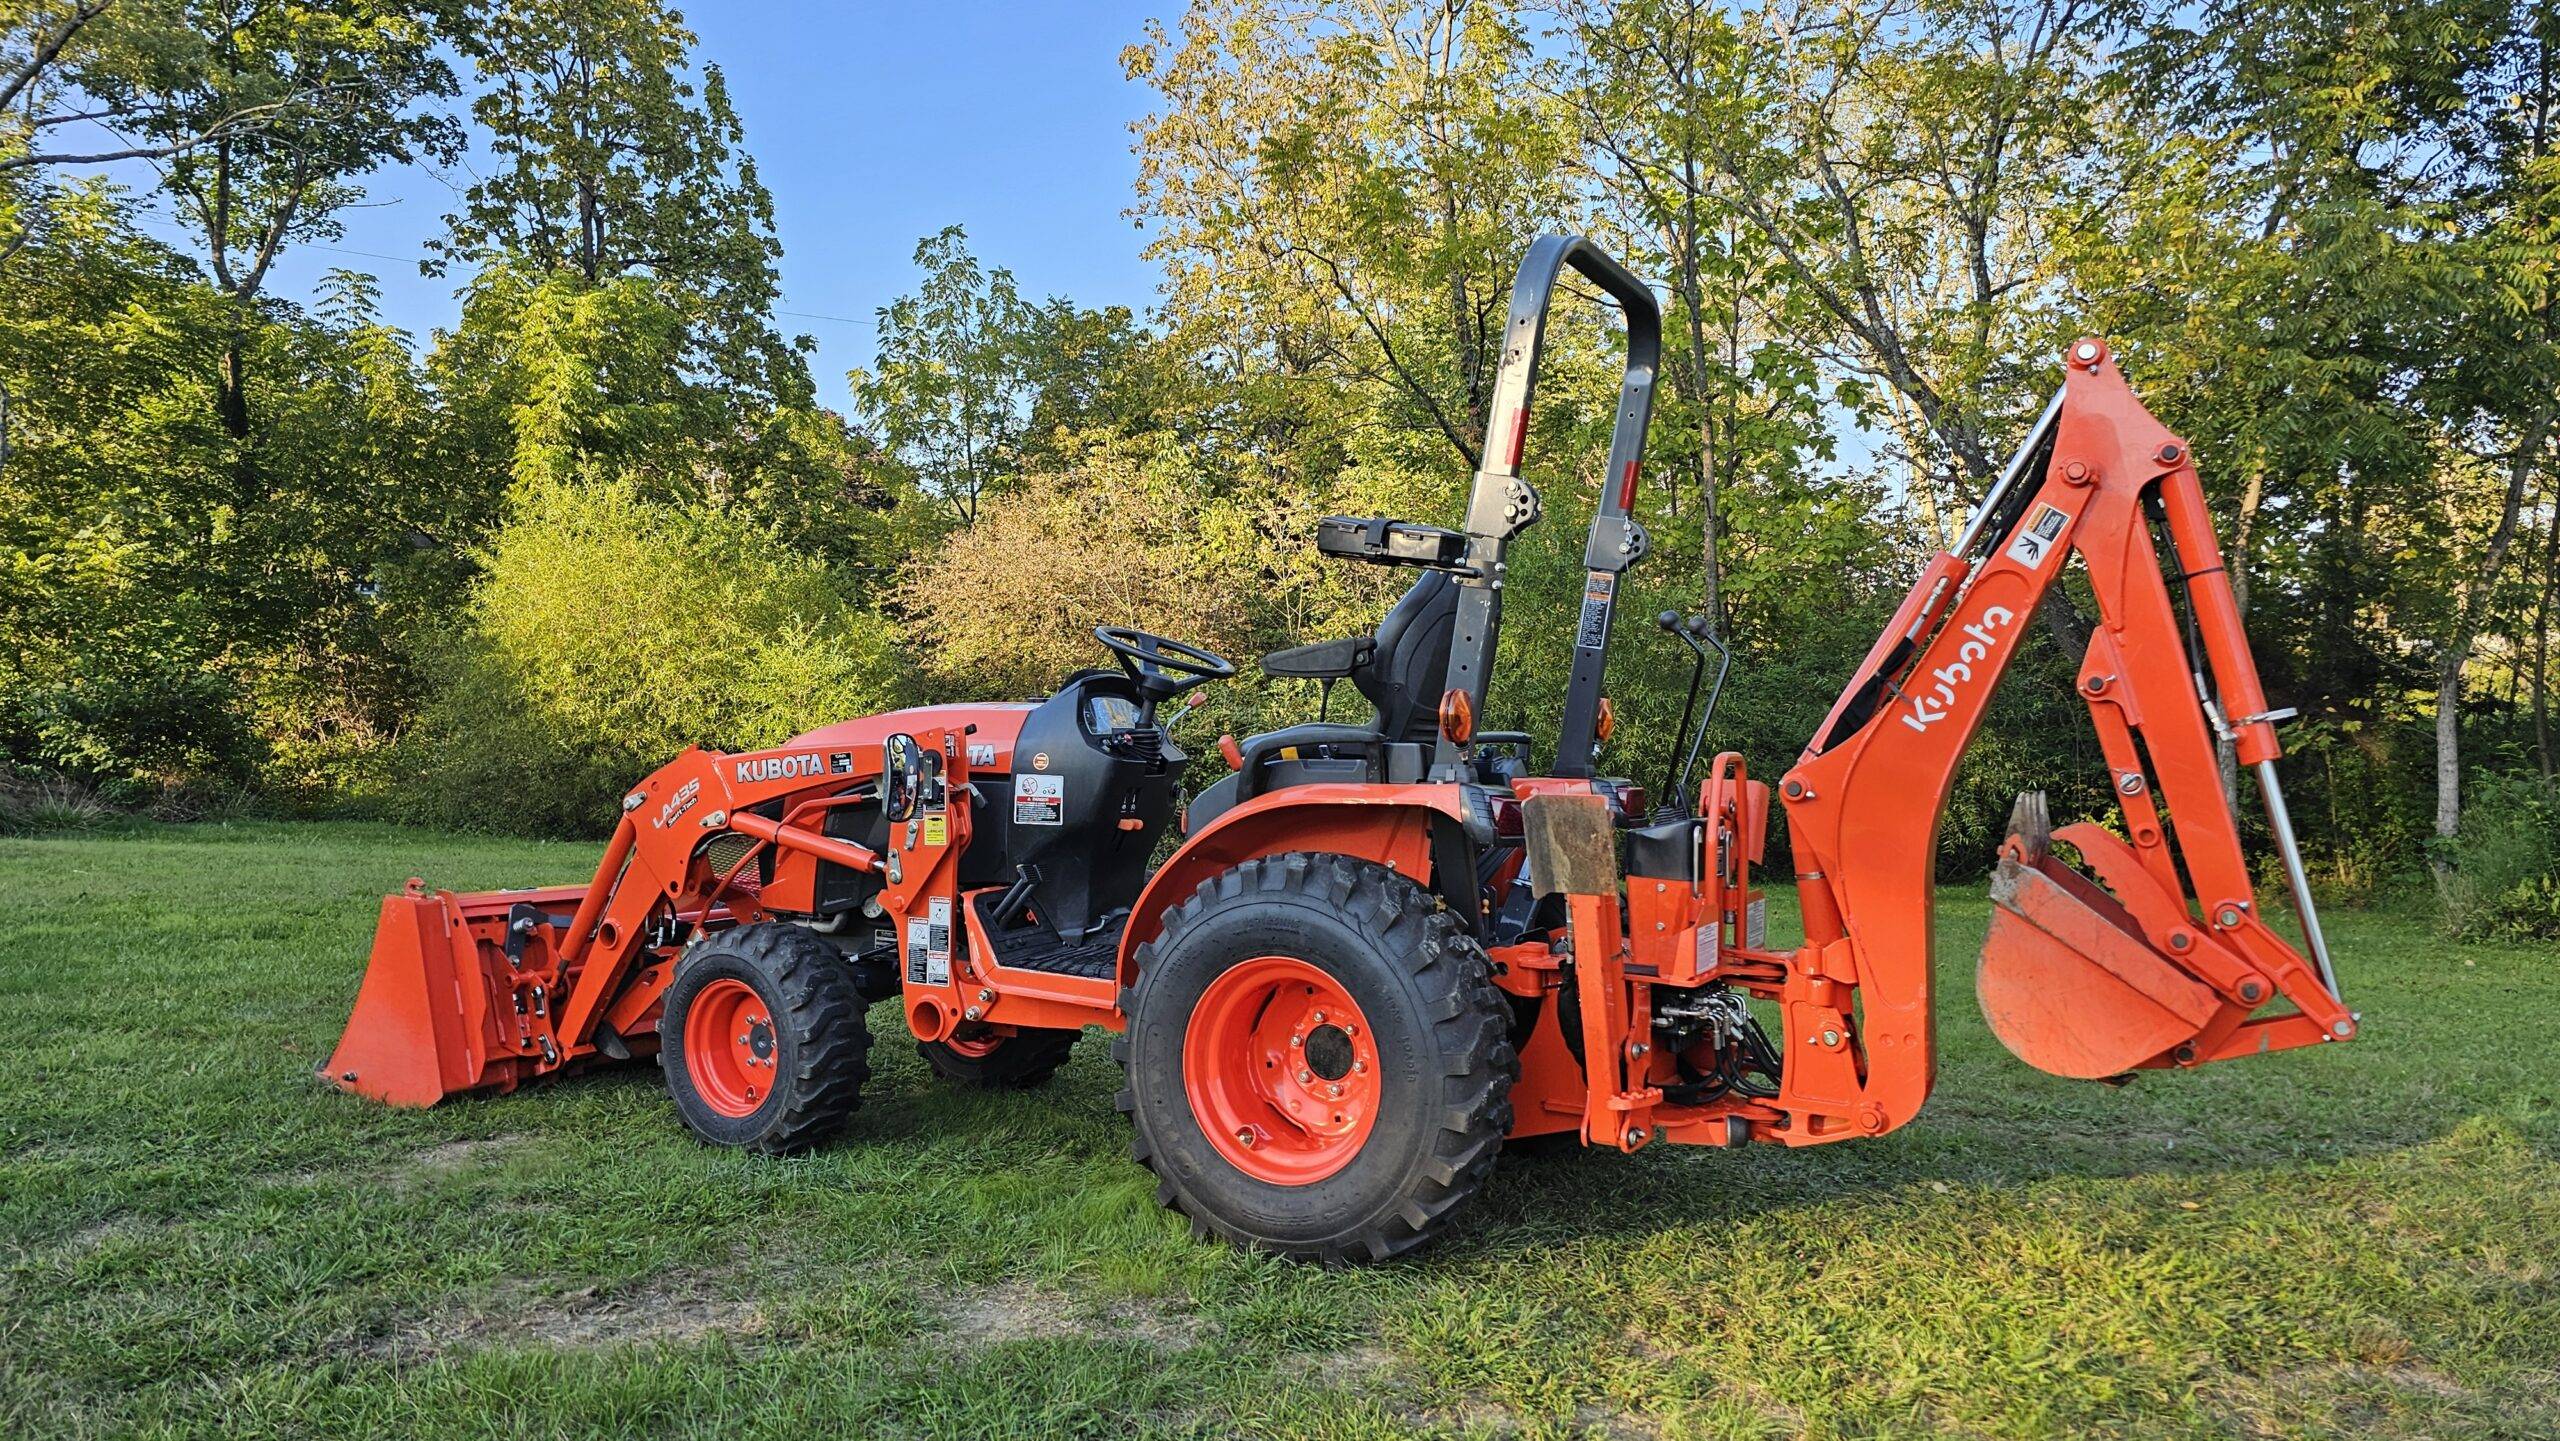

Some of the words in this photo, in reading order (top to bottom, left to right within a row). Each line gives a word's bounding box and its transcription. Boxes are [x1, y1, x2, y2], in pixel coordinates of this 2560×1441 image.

[1902, 606, 2015, 732] Kubota
[736, 753, 825, 783] KUBOTA
[653, 776, 700, 829] LA435
